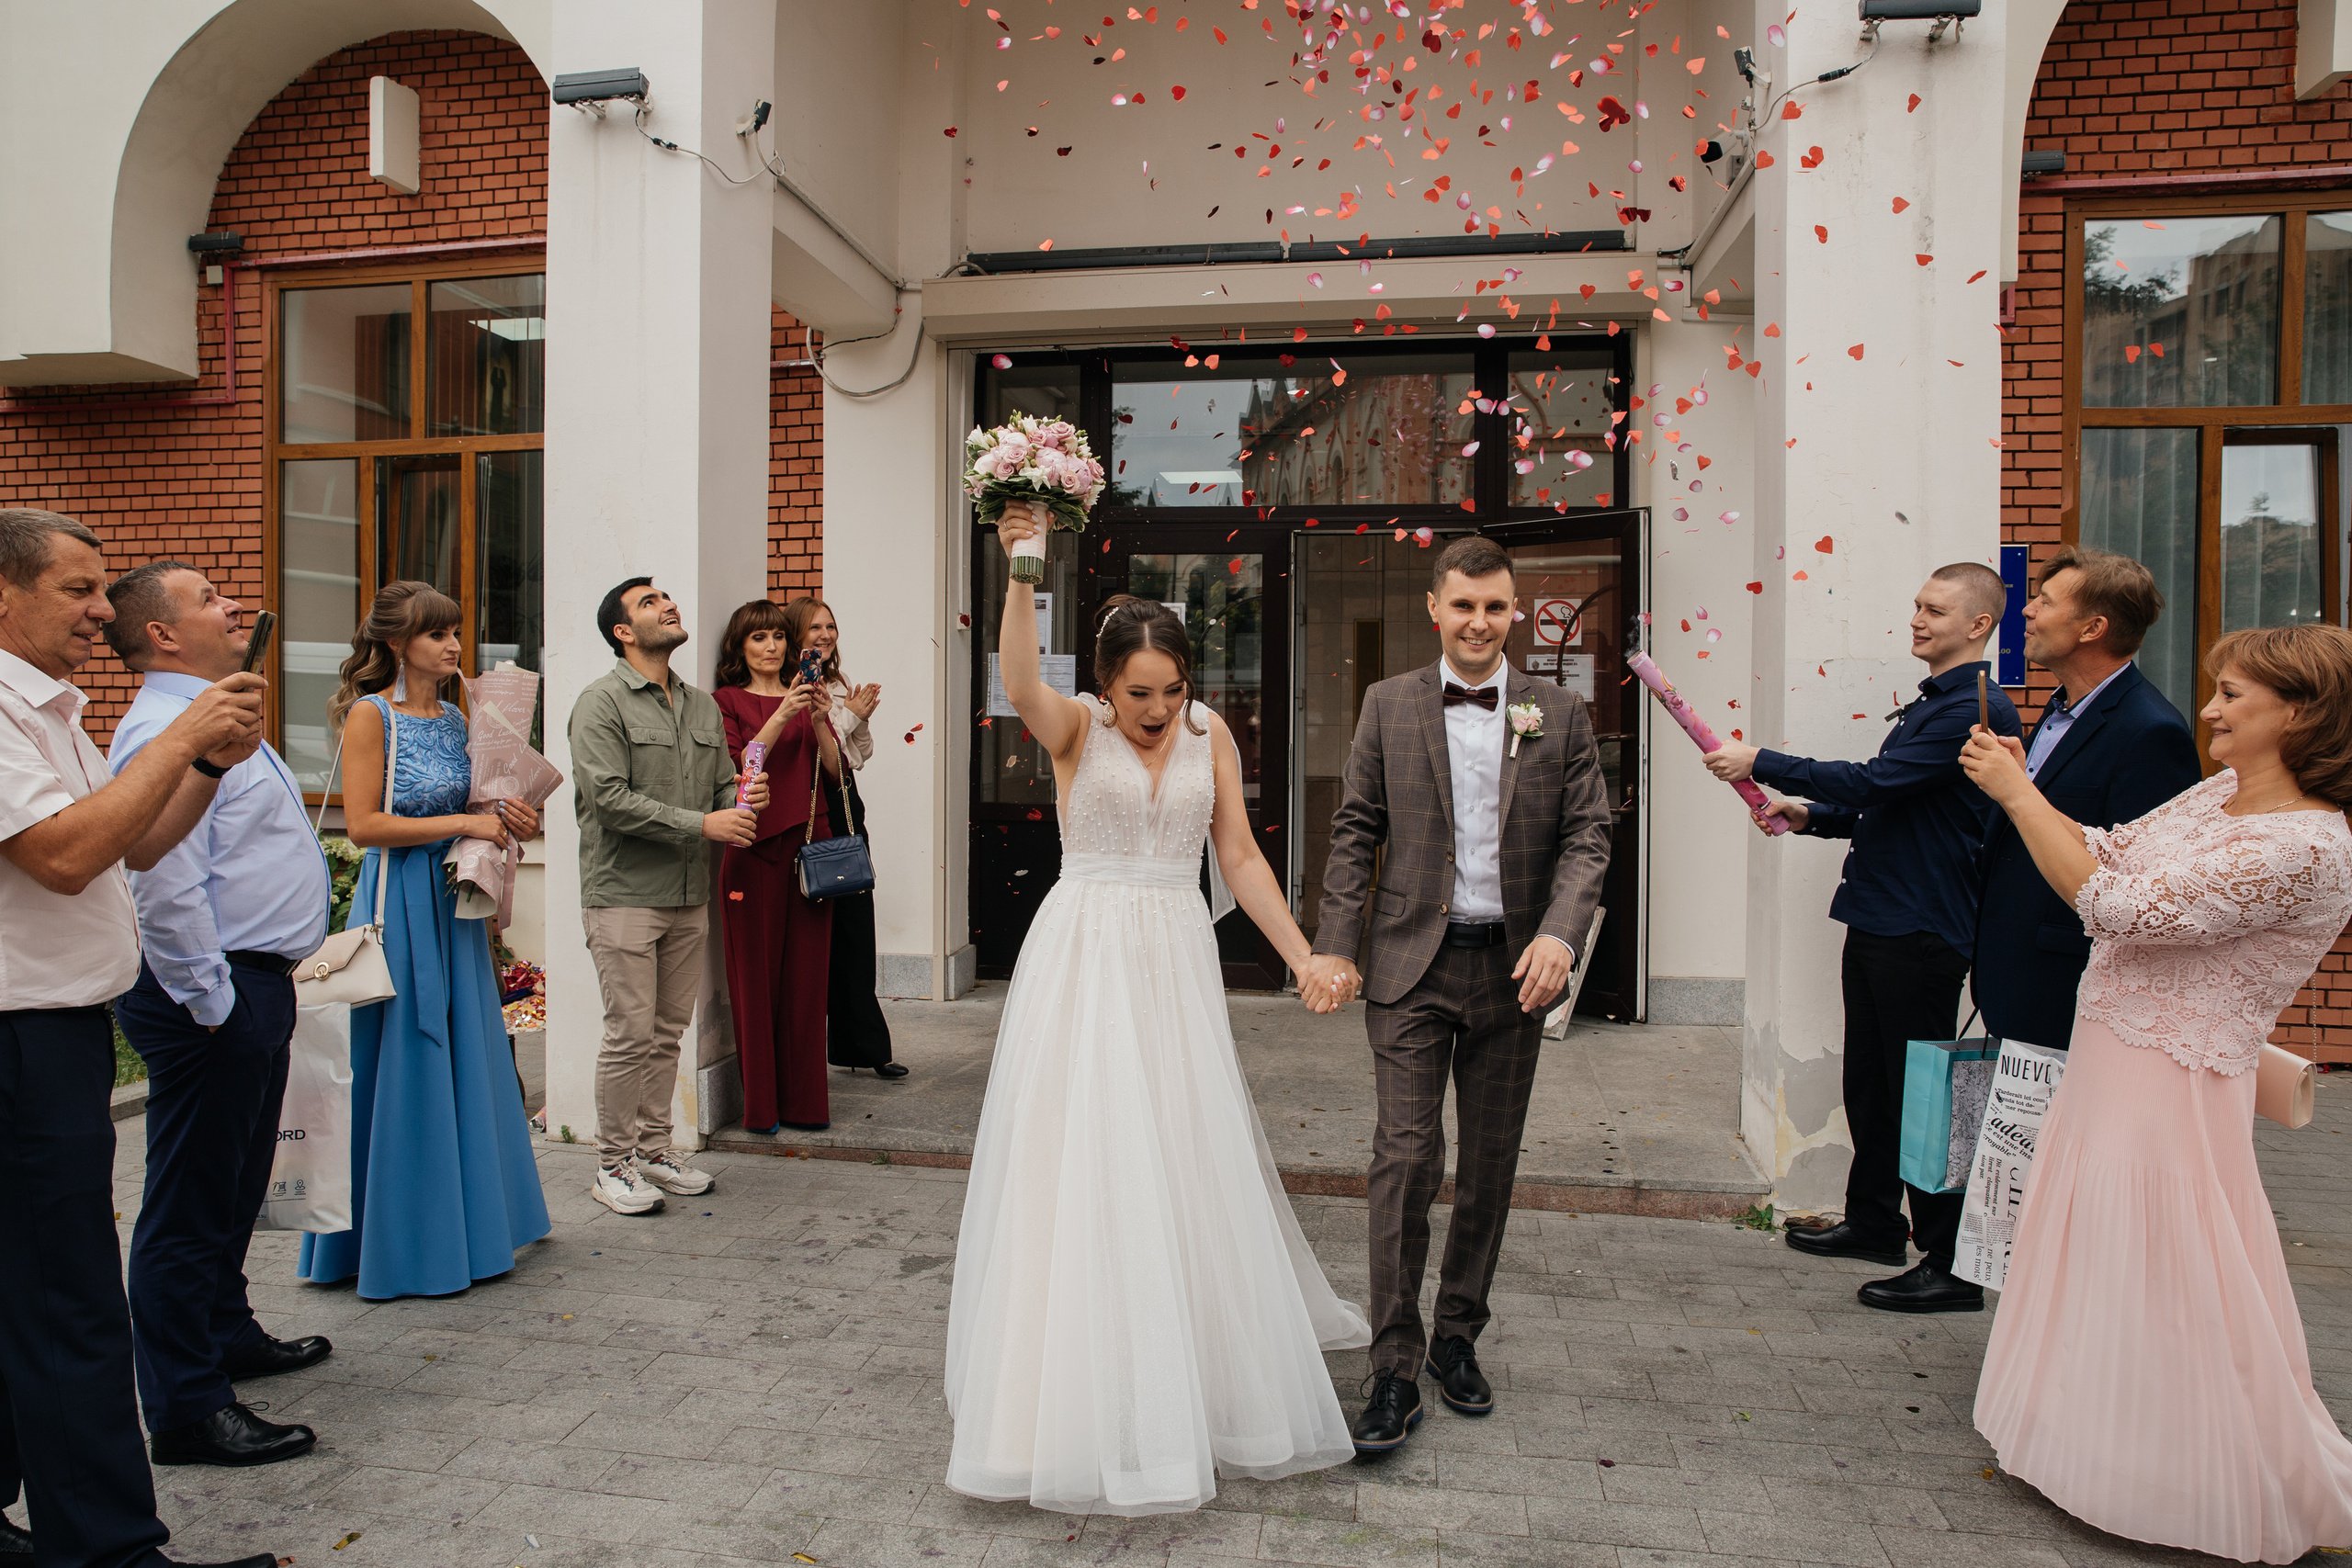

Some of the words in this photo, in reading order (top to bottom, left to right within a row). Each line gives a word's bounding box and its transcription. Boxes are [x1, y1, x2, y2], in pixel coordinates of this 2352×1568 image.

[1990, 1117, 2034, 1154] adea
[1993, 1131, 2003, 1140] est
[2004, 1139, 2018, 1150] une
[2019, 1148, 2033, 1161] ins
[1976, 1245, 1984, 1257] les
[1987, 1248, 1993, 1259] ne
[1984, 1261, 1993, 1282] peux
